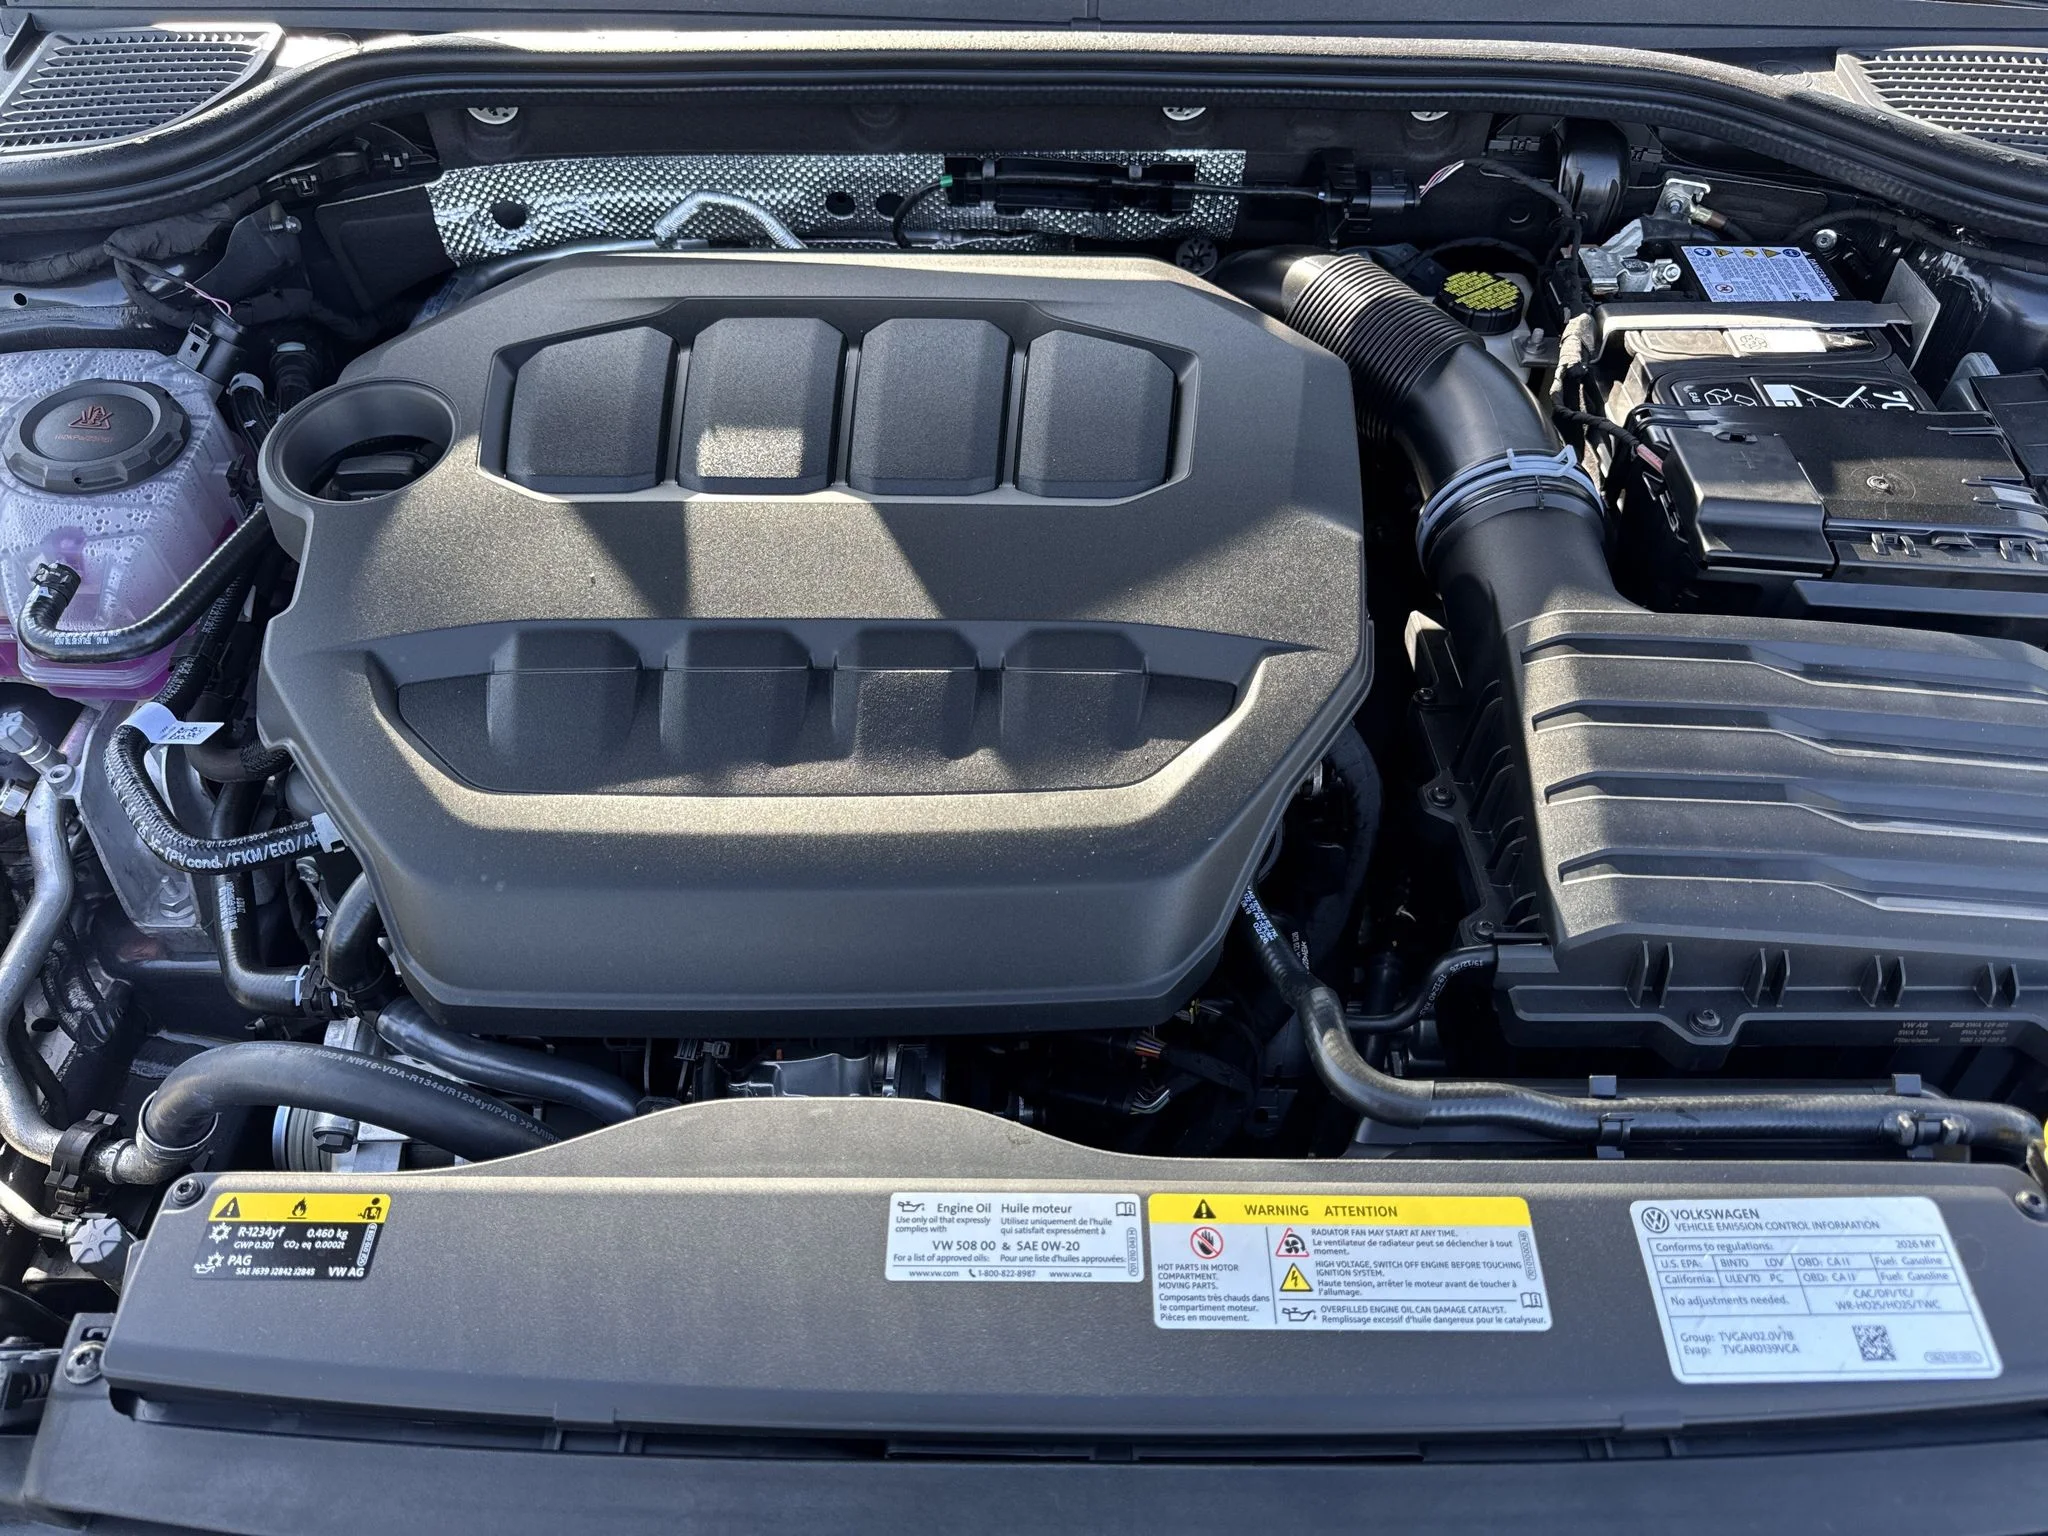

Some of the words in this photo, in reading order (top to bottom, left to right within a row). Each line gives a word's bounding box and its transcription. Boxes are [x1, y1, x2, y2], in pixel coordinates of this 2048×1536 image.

[937, 1204, 974, 1215] Engine
[976, 1203, 992, 1213] Oil
[1001, 1204, 1030, 1214] Huile
[1032, 1204, 1072, 1214] moteur
[1244, 1204, 1308, 1216] WARNING
[1324, 1206, 1398, 1217] ATTENTION
[1670, 1208, 1760, 1220] VOLKSWAGEN
[912, 1216, 927, 1225] only
[956, 1216, 990, 1226] expressly
[1030, 1218, 1076, 1226] uniquement
[1674, 1222, 1715, 1232] VEHICLE
[1716, 1222, 1763, 1231] EMISSION
[1765, 1222, 1810, 1230] CONTROL
[1812, 1220, 1880, 1230] INFORMATION
[238, 1226, 286, 1238] R-1234yf
[306, 1228, 334, 1238] 0.460
[336, 1228, 349, 1240] kg
[896, 1225, 928, 1234] complies
[1000, 1227, 1013, 1236] qui
[1046, 1227, 1100, 1236] expressément
[234, 1241, 254, 1249] GWP
[254, 1241, 274, 1249] 0.501
[302, 1242, 312, 1250] eq
[932, 1240, 953, 1250] VW
[956, 1240, 978, 1250] 508
[980, 1240, 996, 1250] 00
[1002, 1242, 1011, 1250] &
[1017, 1241, 1038, 1251] SAE
[1041, 1241, 1080, 1251] 0W-20
[1656, 1242, 1701, 1252] Conforms
[1704, 1243, 1715, 1251] to
[1896, 1240, 1918, 1248] 2026
[1920, 1240, 1936, 1248] MY
[227, 1255, 252, 1266] PAG
[937, 1254, 972, 1263] approved
[236, 1267, 251, 1276] SAE
[328, 1266, 348, 1277] VW
[348, 1267, 365, 1278] AG
[978, 1270, 1036, 1278] 1-800-822-8987
[1160, 1294, 1206, 1302] Composants
[1670, 1296, 1685, 1305] No
[1687, 1296, 1748, 1308] adjustments
[1322, 1316, 1371, 1324] Remplissage
[1433, 1316, 1474, 1324] dangereux
